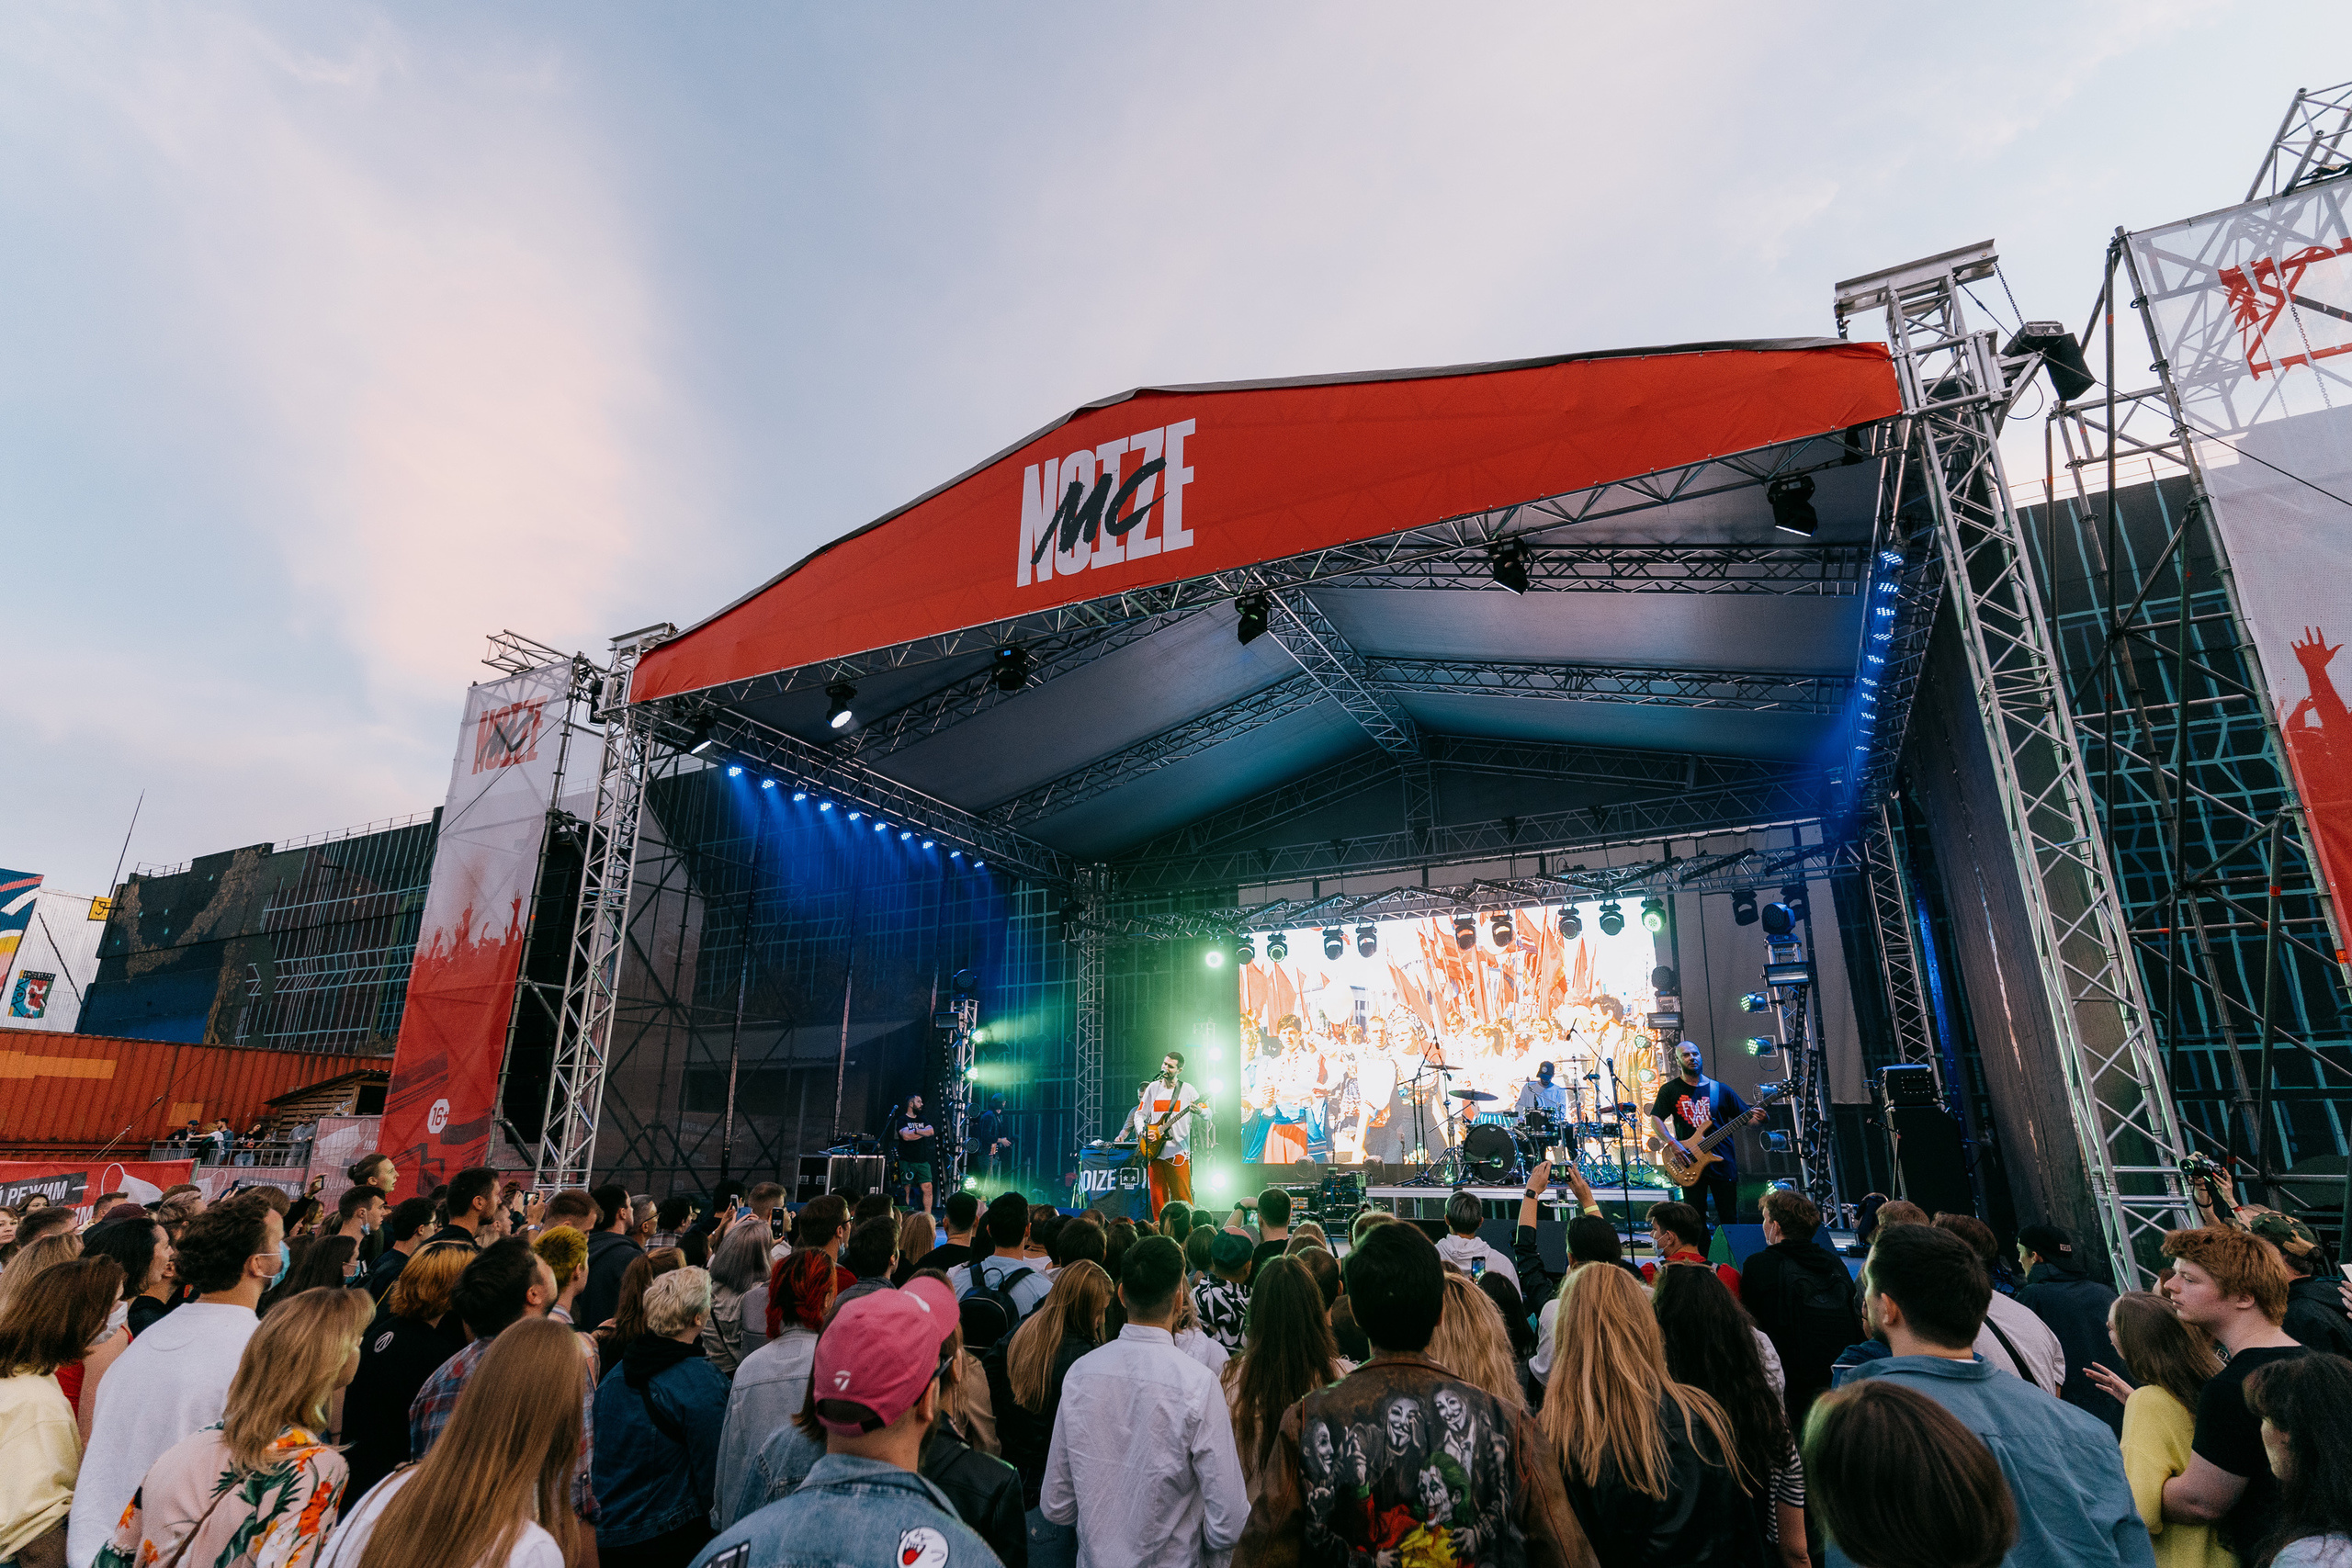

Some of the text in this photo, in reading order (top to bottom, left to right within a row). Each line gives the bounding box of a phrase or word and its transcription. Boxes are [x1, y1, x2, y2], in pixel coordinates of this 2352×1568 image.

[1017, 418, 1195, 587] NOIZE
[1031, 457, 1169, 564] MC
[471, 694, 548, 774] NOIZE
[432, 1106, 448, 1126] 16+
[1079, 1168, 1116, 1195] NOIZE
